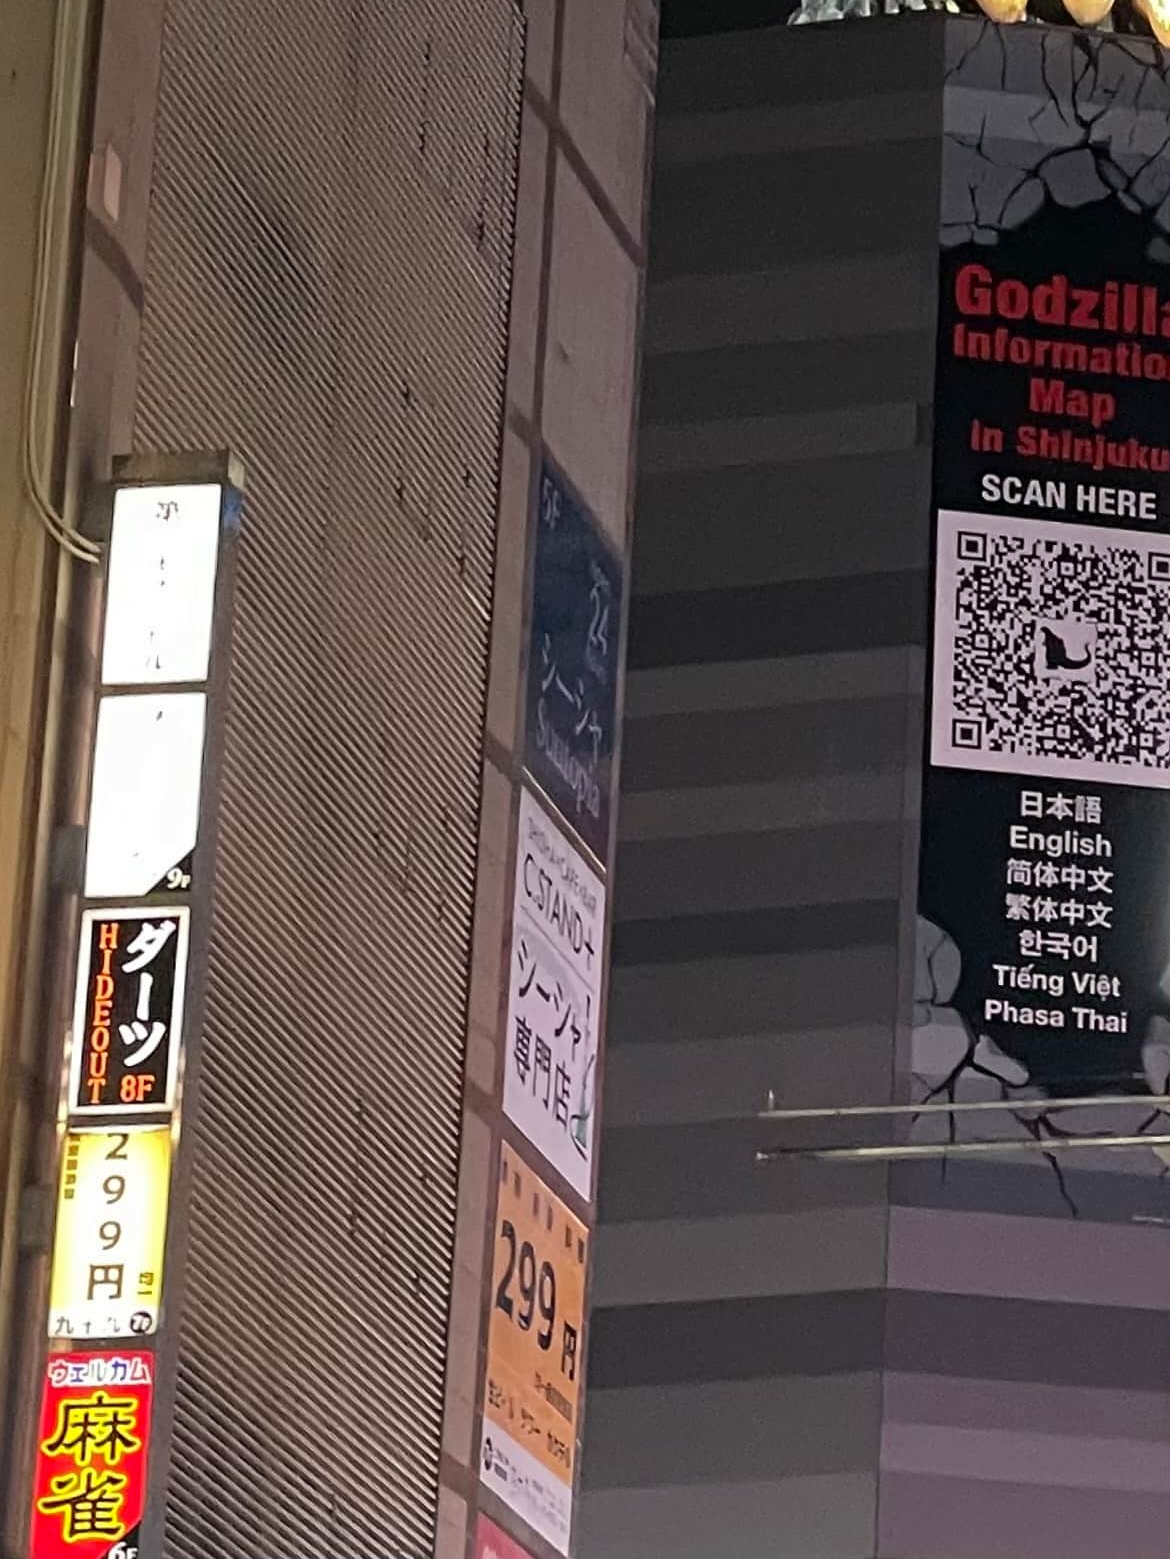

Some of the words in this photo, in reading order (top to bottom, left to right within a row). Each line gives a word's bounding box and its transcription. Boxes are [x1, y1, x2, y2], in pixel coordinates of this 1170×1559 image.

[1028, 377, 1116, 428] Map
[981, 474, 1066, 510] SCAN
[1076, 484, 1158, 520] HERE
[1019, 790, 1102, 825] 日本語
[1009, 826, 1113, 858] English
[1005, 858, 1114, 894] 简体中文
[1005, 893, 1114, 929] 繁体中文
[1018, 929, 1099, 963] 한국어
[118, 920, 177, 1067] ダーツ
[517, 938, 582, 1062] シーシャ
[992, 962, 1064, 996] Tiếng
[1071, 971, 1121, 1002] Việt
[88, 923, 120, 1105] HIDEOUT
[984, 999, 1064, 1028] Phasa
[1071, 1007, 1128, 1034] Thai
[119, 1074, 155, 1103] 8F
[513, 1015, 572, 1134] 専門店
[86, 1132, 131, 1301] 299円
[39, 1392, 141, 1542] 麻雀
